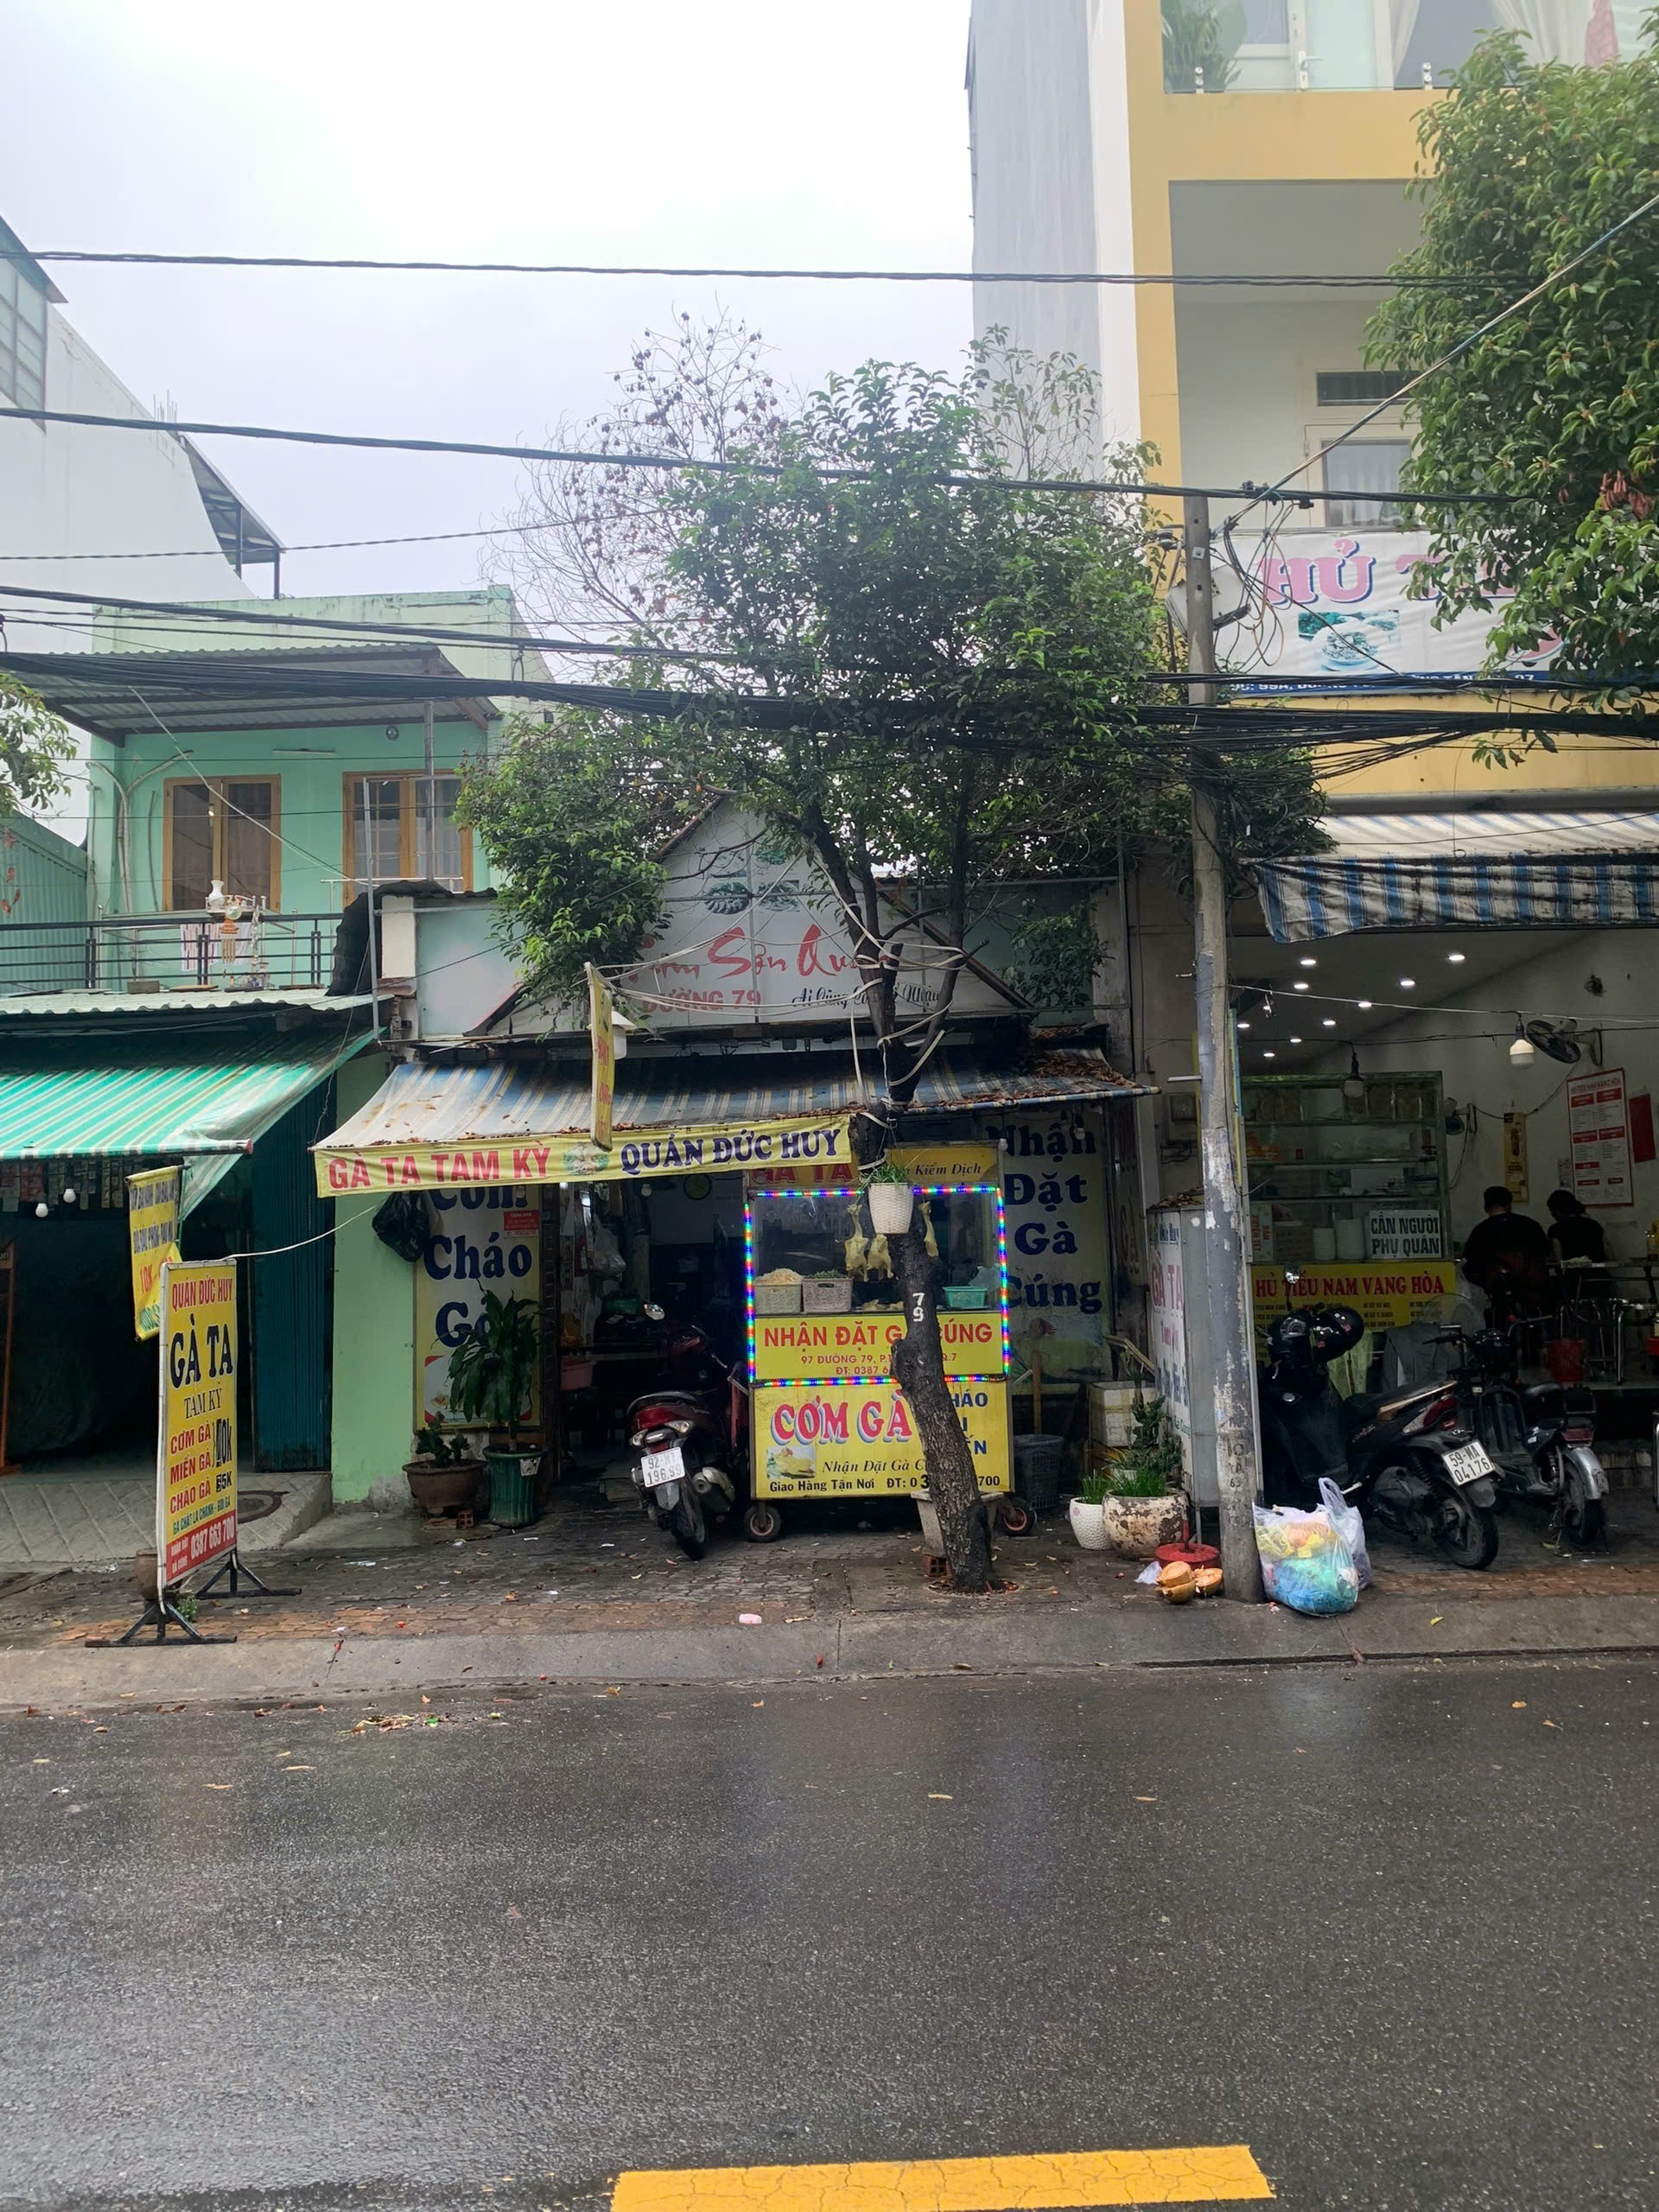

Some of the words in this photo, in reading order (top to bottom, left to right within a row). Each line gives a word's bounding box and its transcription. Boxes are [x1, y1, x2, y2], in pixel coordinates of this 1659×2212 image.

[328, 1151, 371, 1190] GÀ
[380, 1155, 422, 1186] TA
[431, 1150, 499, 1182] TAM
[512, 1140, 551, 1179] KỲ
[621, 1134, 703, 1176] QUÁN
[713, 1128, 772, 1164] ĐỨC
[780, 1128, 841, 1159] HUY
[1003, 1172, 1088, 1211] Đặt
[423, 1231, 532, 1281] Cháo
[1014, 1221, 1079, 1255] Gà
[172, 1276, 196, 1312] QUÁN
[199, 1274, 215, 1305] ĐỨC
[218, 1278, 232, 1302] HUY
[1255, 1273, 1277, 1297] HỦ
[1323, 1277, 1358, 1296] NAM
[1362, 1276, 1406, 1294] VANG
[1411, 1270, 1445, 1294] HÒA
[170, 1313, 201, 1389] GÀ
[207, 1323, 233, 1378] TA
[764, 1323, 827, 1352] NHẬN
[836, 1321, 878, 1351] ĐẶT
[885, 1325, 903, 1344] G
[939, 1319, 993, 1343] ÚNG
[801, 1355, 813, 1364] 97
[817, 1351, 856, 1364] ĐƯỜNG
[854, 1365, 878, 1375] 0387
[184, 1391, 207, 1420] TAM
[208, 1381, 221, 1412] KỲ
[772, 1395, 850, 1445] CƠM
[858, 1389, 913, 1442] GÀ
[170, 1428, 195, 1455] CƠM
[198, 1420, 212, 1444] GÀ
[170, 1452, 197, 1486] MIẾN
[199, 1447, 212, 1471] GÀ
[770, 1478, 794, 1492] Giao
[798, 1478, 827, 1492] Hàng
[831, 1478, 853, 1491] Tận
[856, 1477, 875, 1490] Nơi
[887, 1478, 906, 1489] ĐT:
[823, 1460, 859, 1475] Nhận
[863, 1459, 887, 1474] Đặt
[891, 1459, 910, 1471] Gà
[170, 1485, 197, 1515] CHÁO
[199, 1477, 211, 1500] GÀ
[191, 1529, 208, 1560] 0387
[209, 1522, 222, 1549] 663
[223, 1516, 235, 1542] 700
